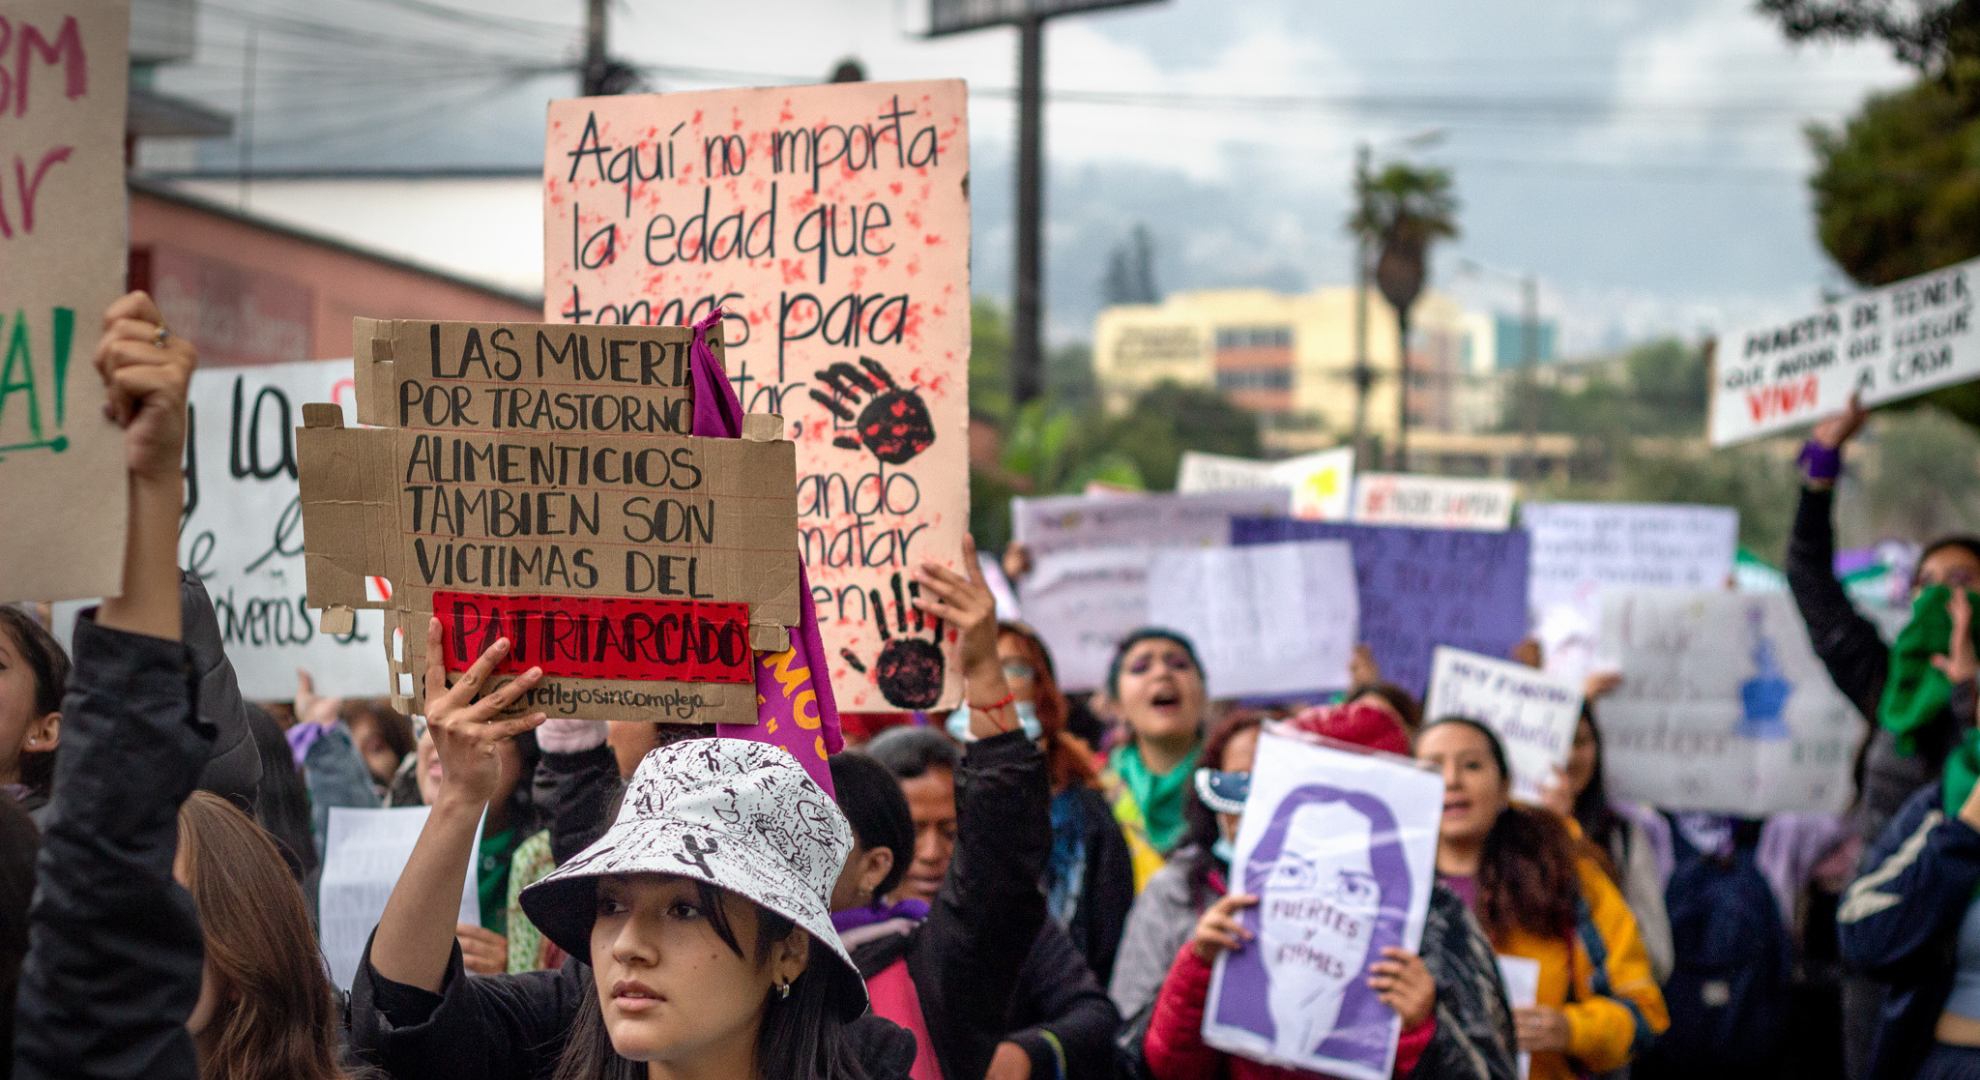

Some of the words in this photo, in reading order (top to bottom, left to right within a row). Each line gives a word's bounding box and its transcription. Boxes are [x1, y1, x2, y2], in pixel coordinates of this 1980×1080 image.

[567, 111, 686, 218] Aquí
[704, 134, 746, 179] no
[771, 94, 939, 194] importa
[573, 202, 616, 271] la
[645, 181, 776, 266] edad
[793, 202, 896, 284] que
[429, 323, 522, 382] LAS
[536, 330, 720, 388] MUERT
[779, 291, 909, 383] para
[0, 307, 74, 452] A!
[400, 379, 480, 428] POR
[484, 387, 694, 435] TRASTORNO
[1746, 373, 1819, 423] VIVA
[230, 374, 299, 481] la
[406, 434, 703, 490] ALIMENTICIOS
[797, 460, 920, 518] ando
[403, 484, 600, 538] TAMBIÉN
[622, 496, 715, 544] SON
[625, 550, 714, 599] DEL
[451, 600, 748, 668] PATRIARCADO
[1271, 900, 1361, 938] FUERTES
